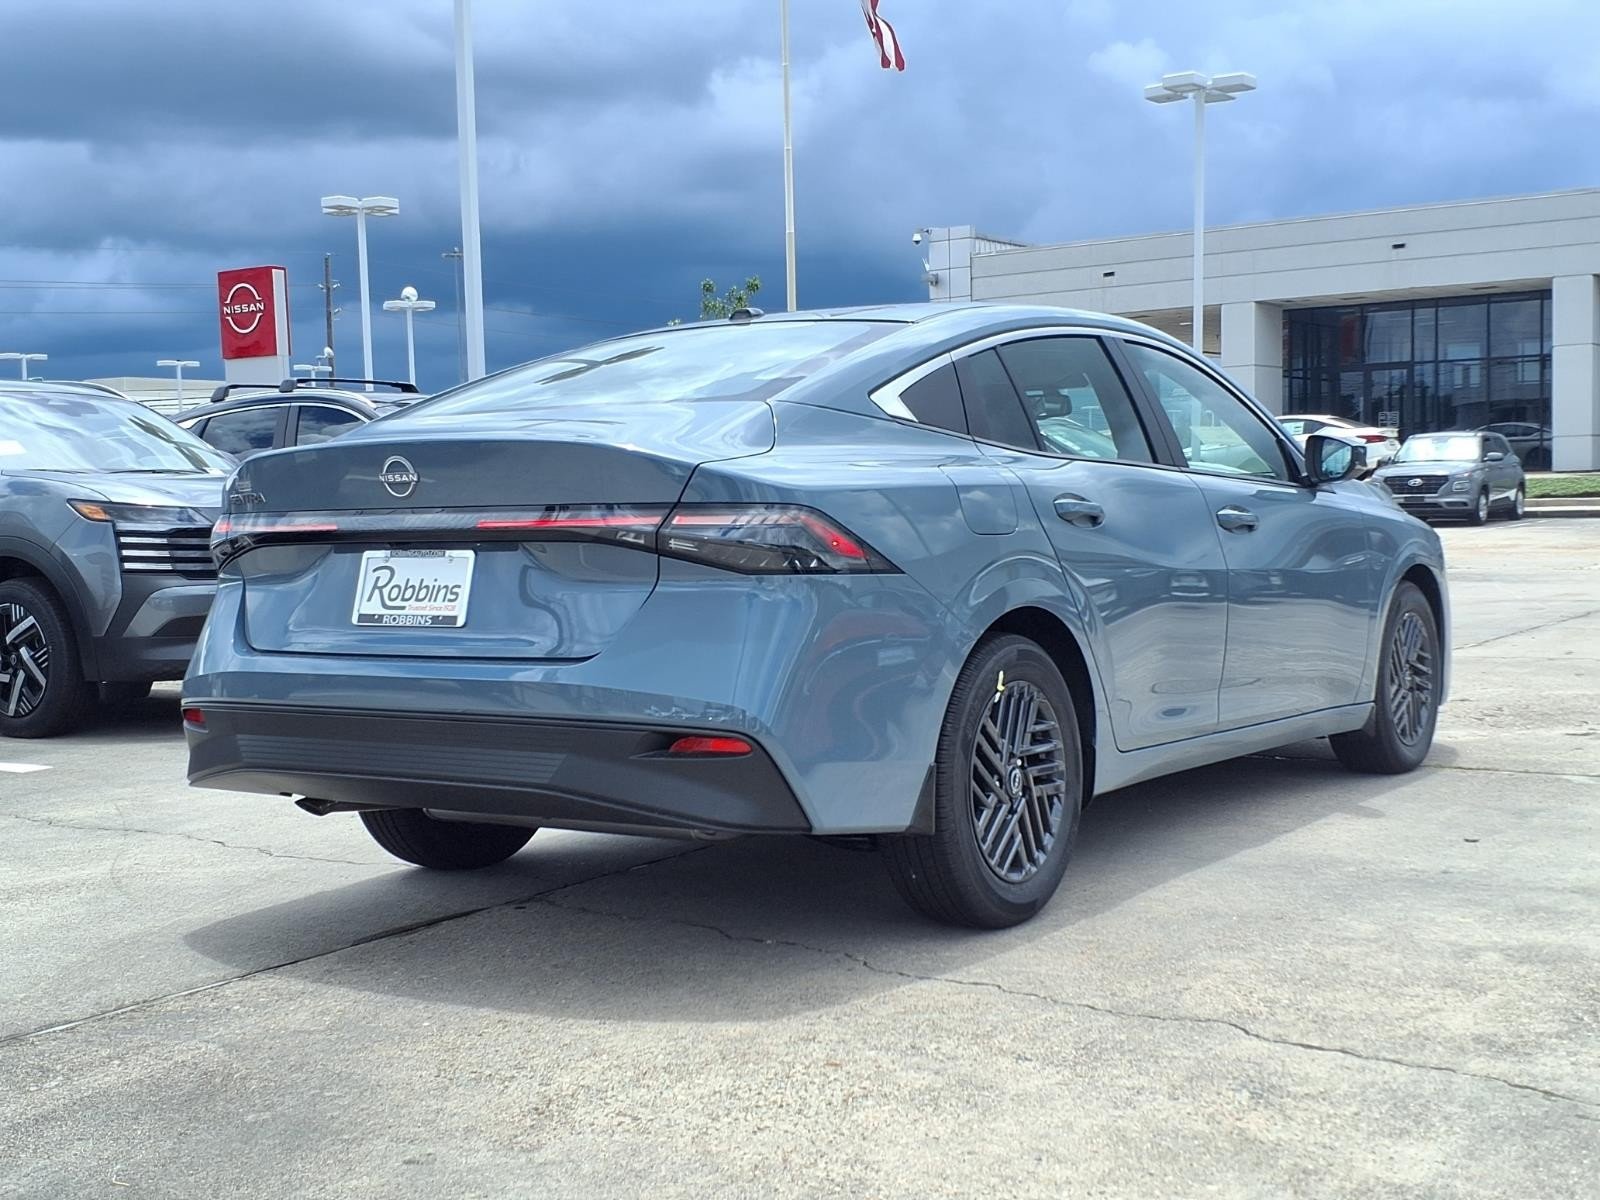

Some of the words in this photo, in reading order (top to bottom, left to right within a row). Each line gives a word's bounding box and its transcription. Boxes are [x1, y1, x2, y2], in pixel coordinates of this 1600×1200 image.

[223, 302, 265, 315] NISSAN
[379, 473, 418, 482] NISSAN
[366, 565, 461, 611] Robbins
[382, 615, 432, 626] ROBBINS
